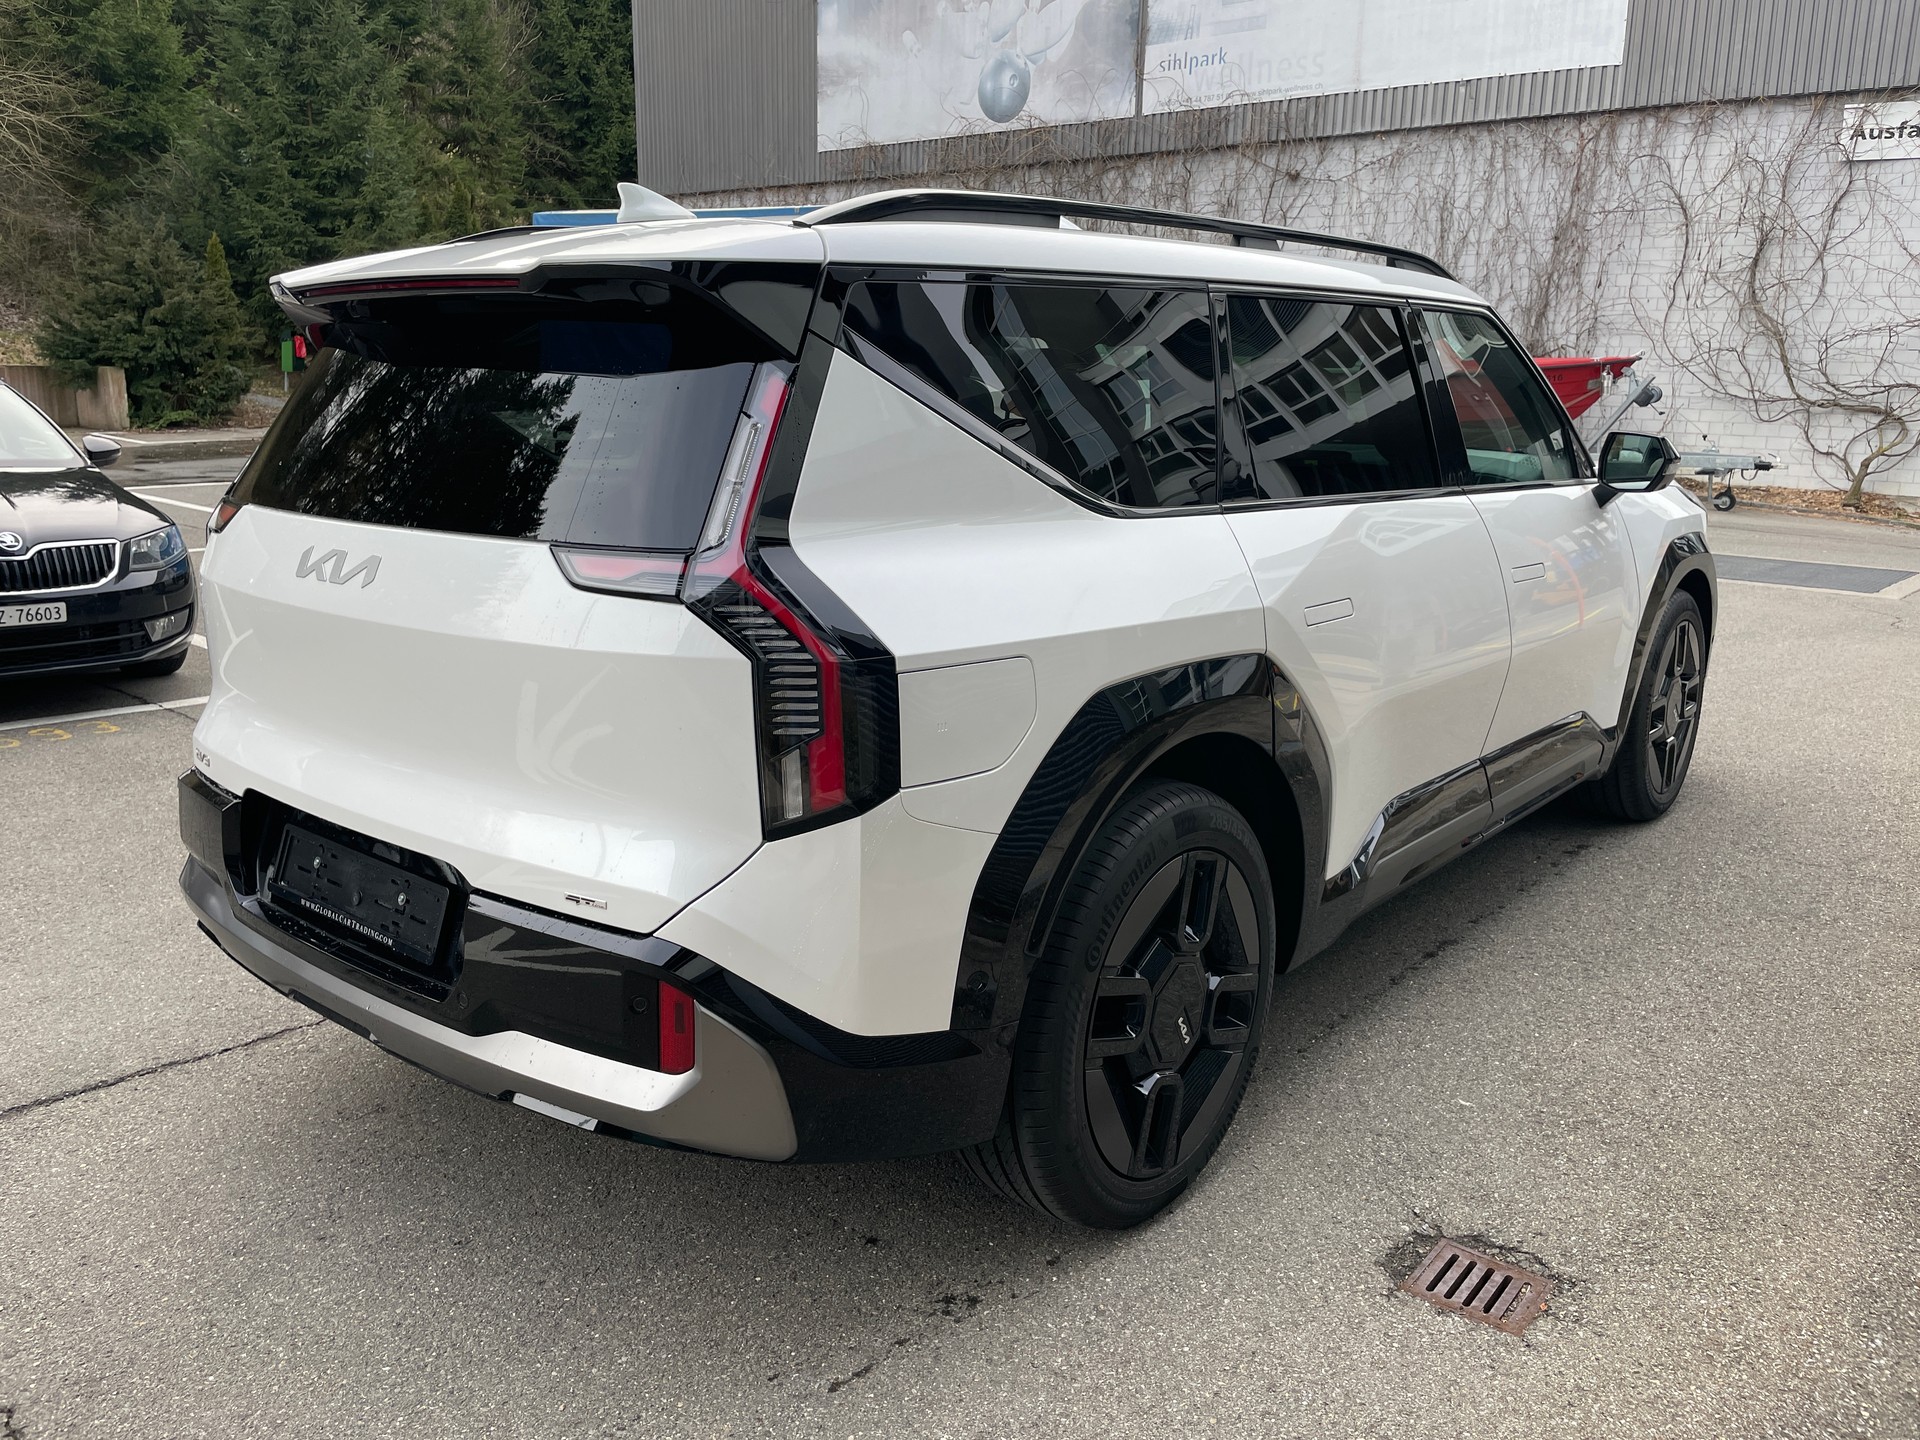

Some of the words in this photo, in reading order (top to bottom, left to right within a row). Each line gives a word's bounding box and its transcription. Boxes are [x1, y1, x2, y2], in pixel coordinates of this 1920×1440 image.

[1159, 46, 1228, 75] sihlpark
[1204, 94, 1215, 102] 787
[1216, 92, 1225, 101] 51
[16, 606, 62, 623] 76603
[1084, 841, 1157, 972] Continental
